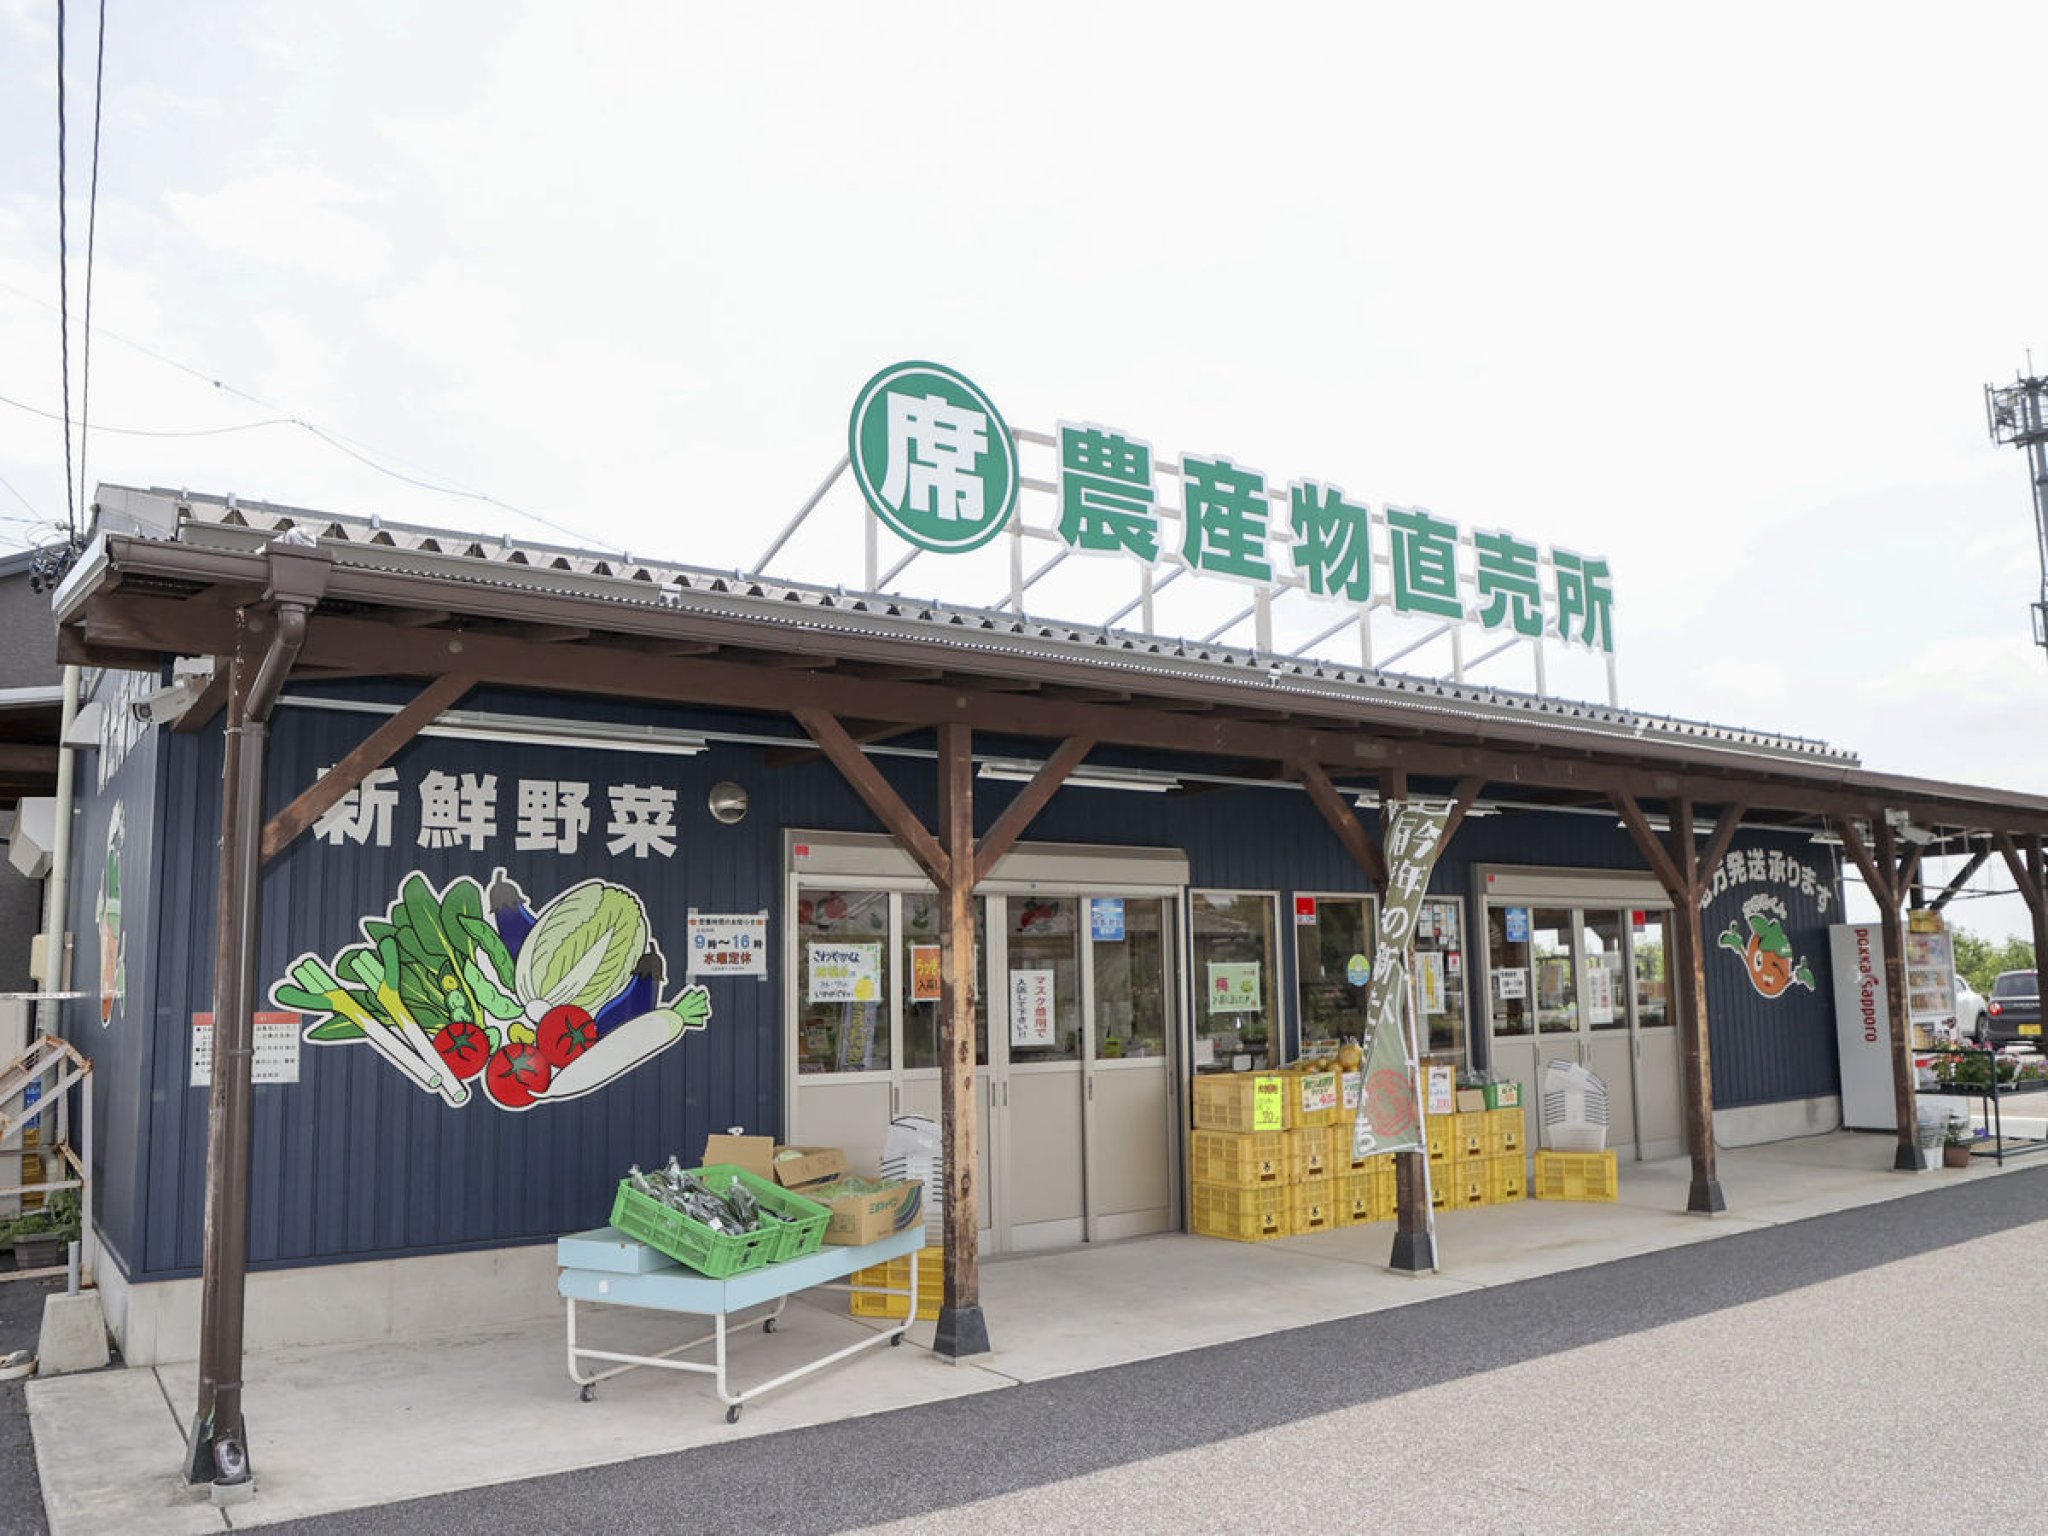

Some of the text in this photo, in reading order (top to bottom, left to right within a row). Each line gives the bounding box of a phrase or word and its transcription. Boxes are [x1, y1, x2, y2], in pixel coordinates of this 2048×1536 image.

[881, 391, 988, 522] 席
[1056, 422, 1615, 654] 農産物直売所
[312, 764, 678, 858] 新鮮野菜
[704, 951, 752, 965] 水曜定休
